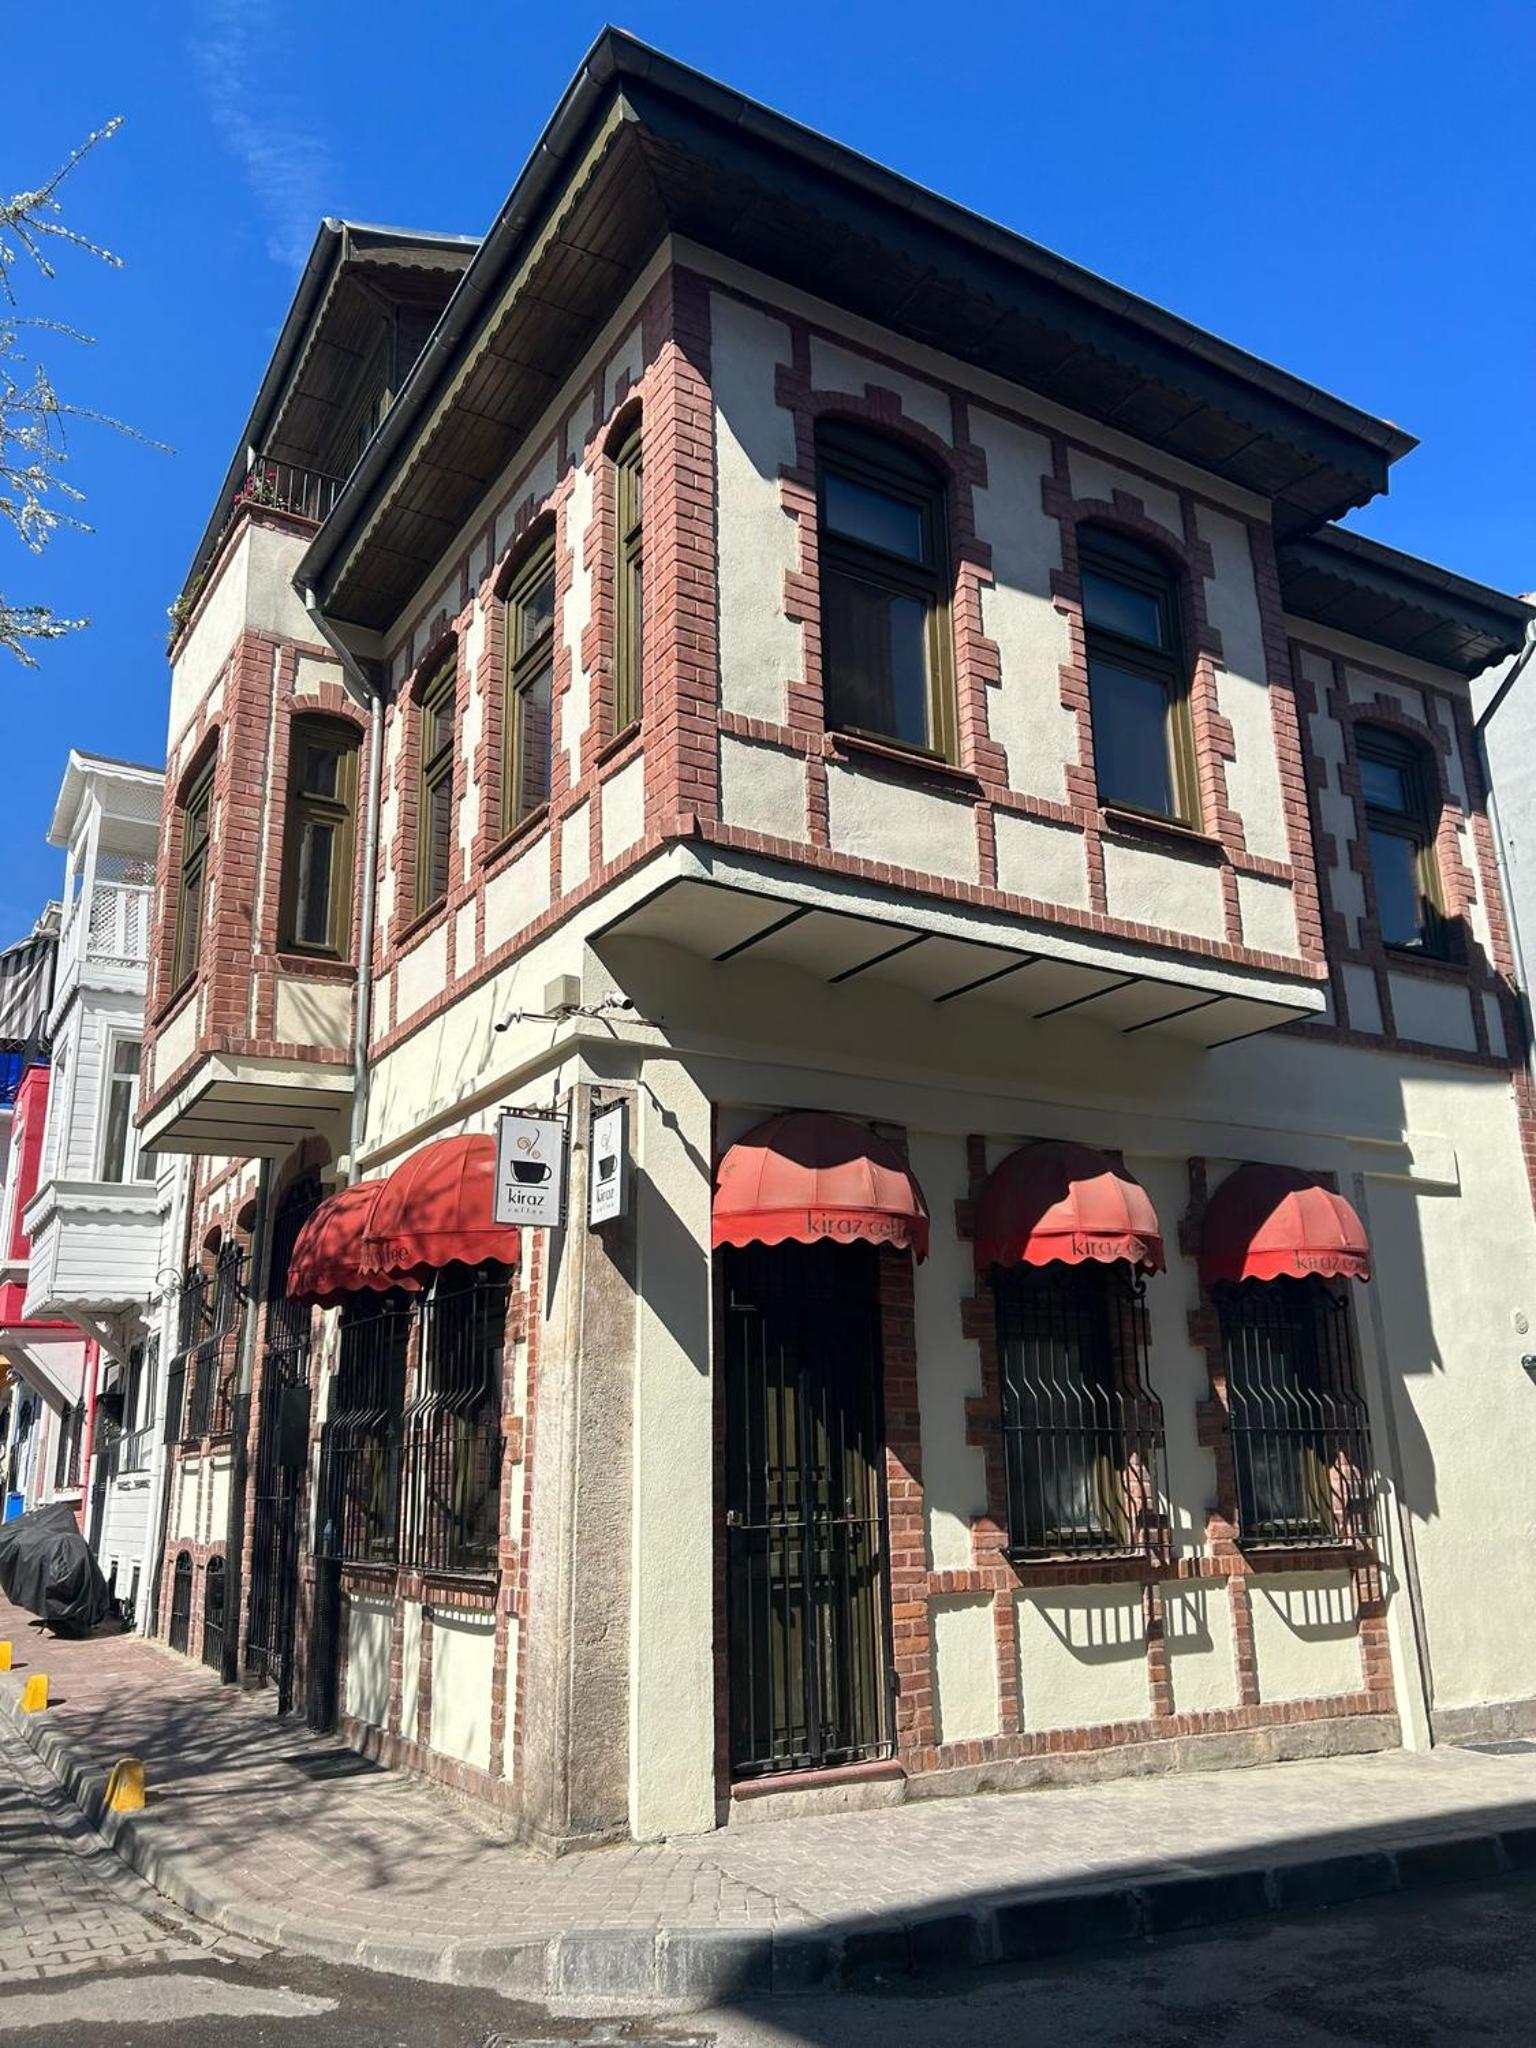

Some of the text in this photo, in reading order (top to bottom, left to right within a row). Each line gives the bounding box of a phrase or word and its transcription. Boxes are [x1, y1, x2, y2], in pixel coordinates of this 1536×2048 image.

[508, 1188, 545, 1206] kiraz
[807, 1211, 862, 1234] kiraz
[1072, 1233, 1121, 1256] kiraz
[1294, 1250, 1340, 1270] kiraz
